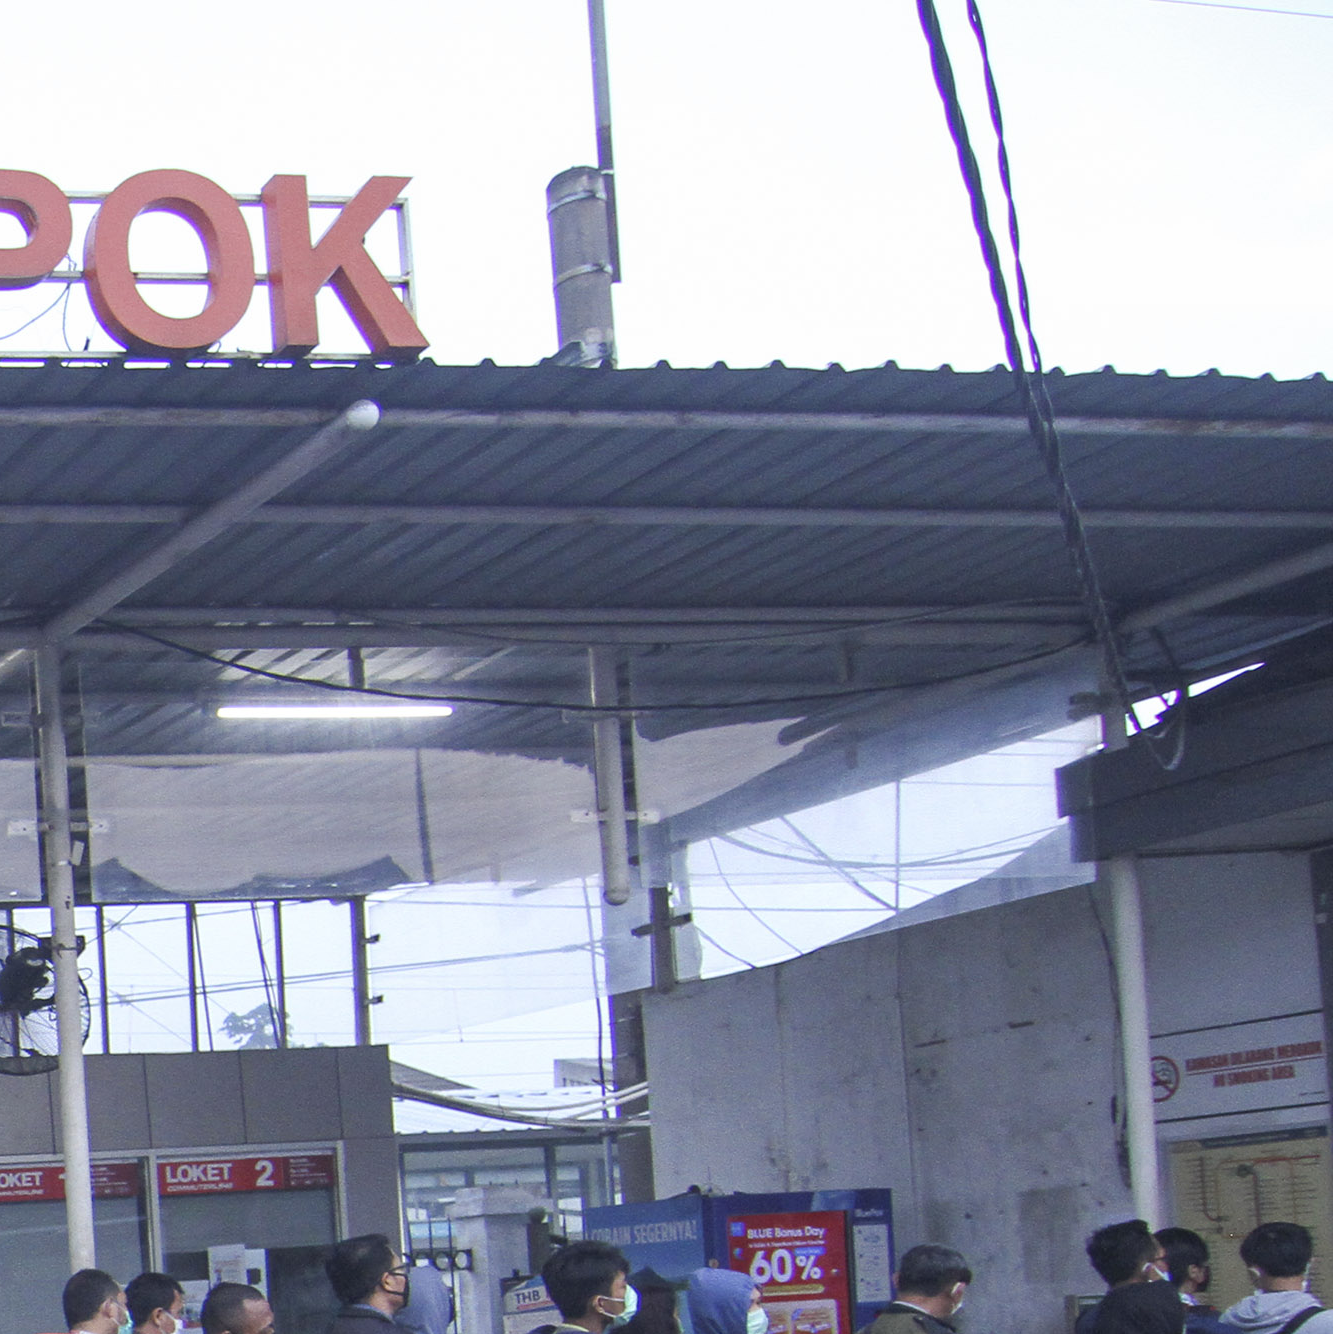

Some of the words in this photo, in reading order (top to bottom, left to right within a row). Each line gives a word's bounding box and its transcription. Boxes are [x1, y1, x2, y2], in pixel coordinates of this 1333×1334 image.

[165, 1163, 233, 1183] LOKET
[254, 1160, 275, 1187] 2
[747, 1228, 773, 1239] BLUE
[774, 1227, 803, 1237] Bonus
[804, 1226, 825, 1239] Day
[749, 1248, 823, 1283] 60%
[514, 1290, 540, 1304] THB
